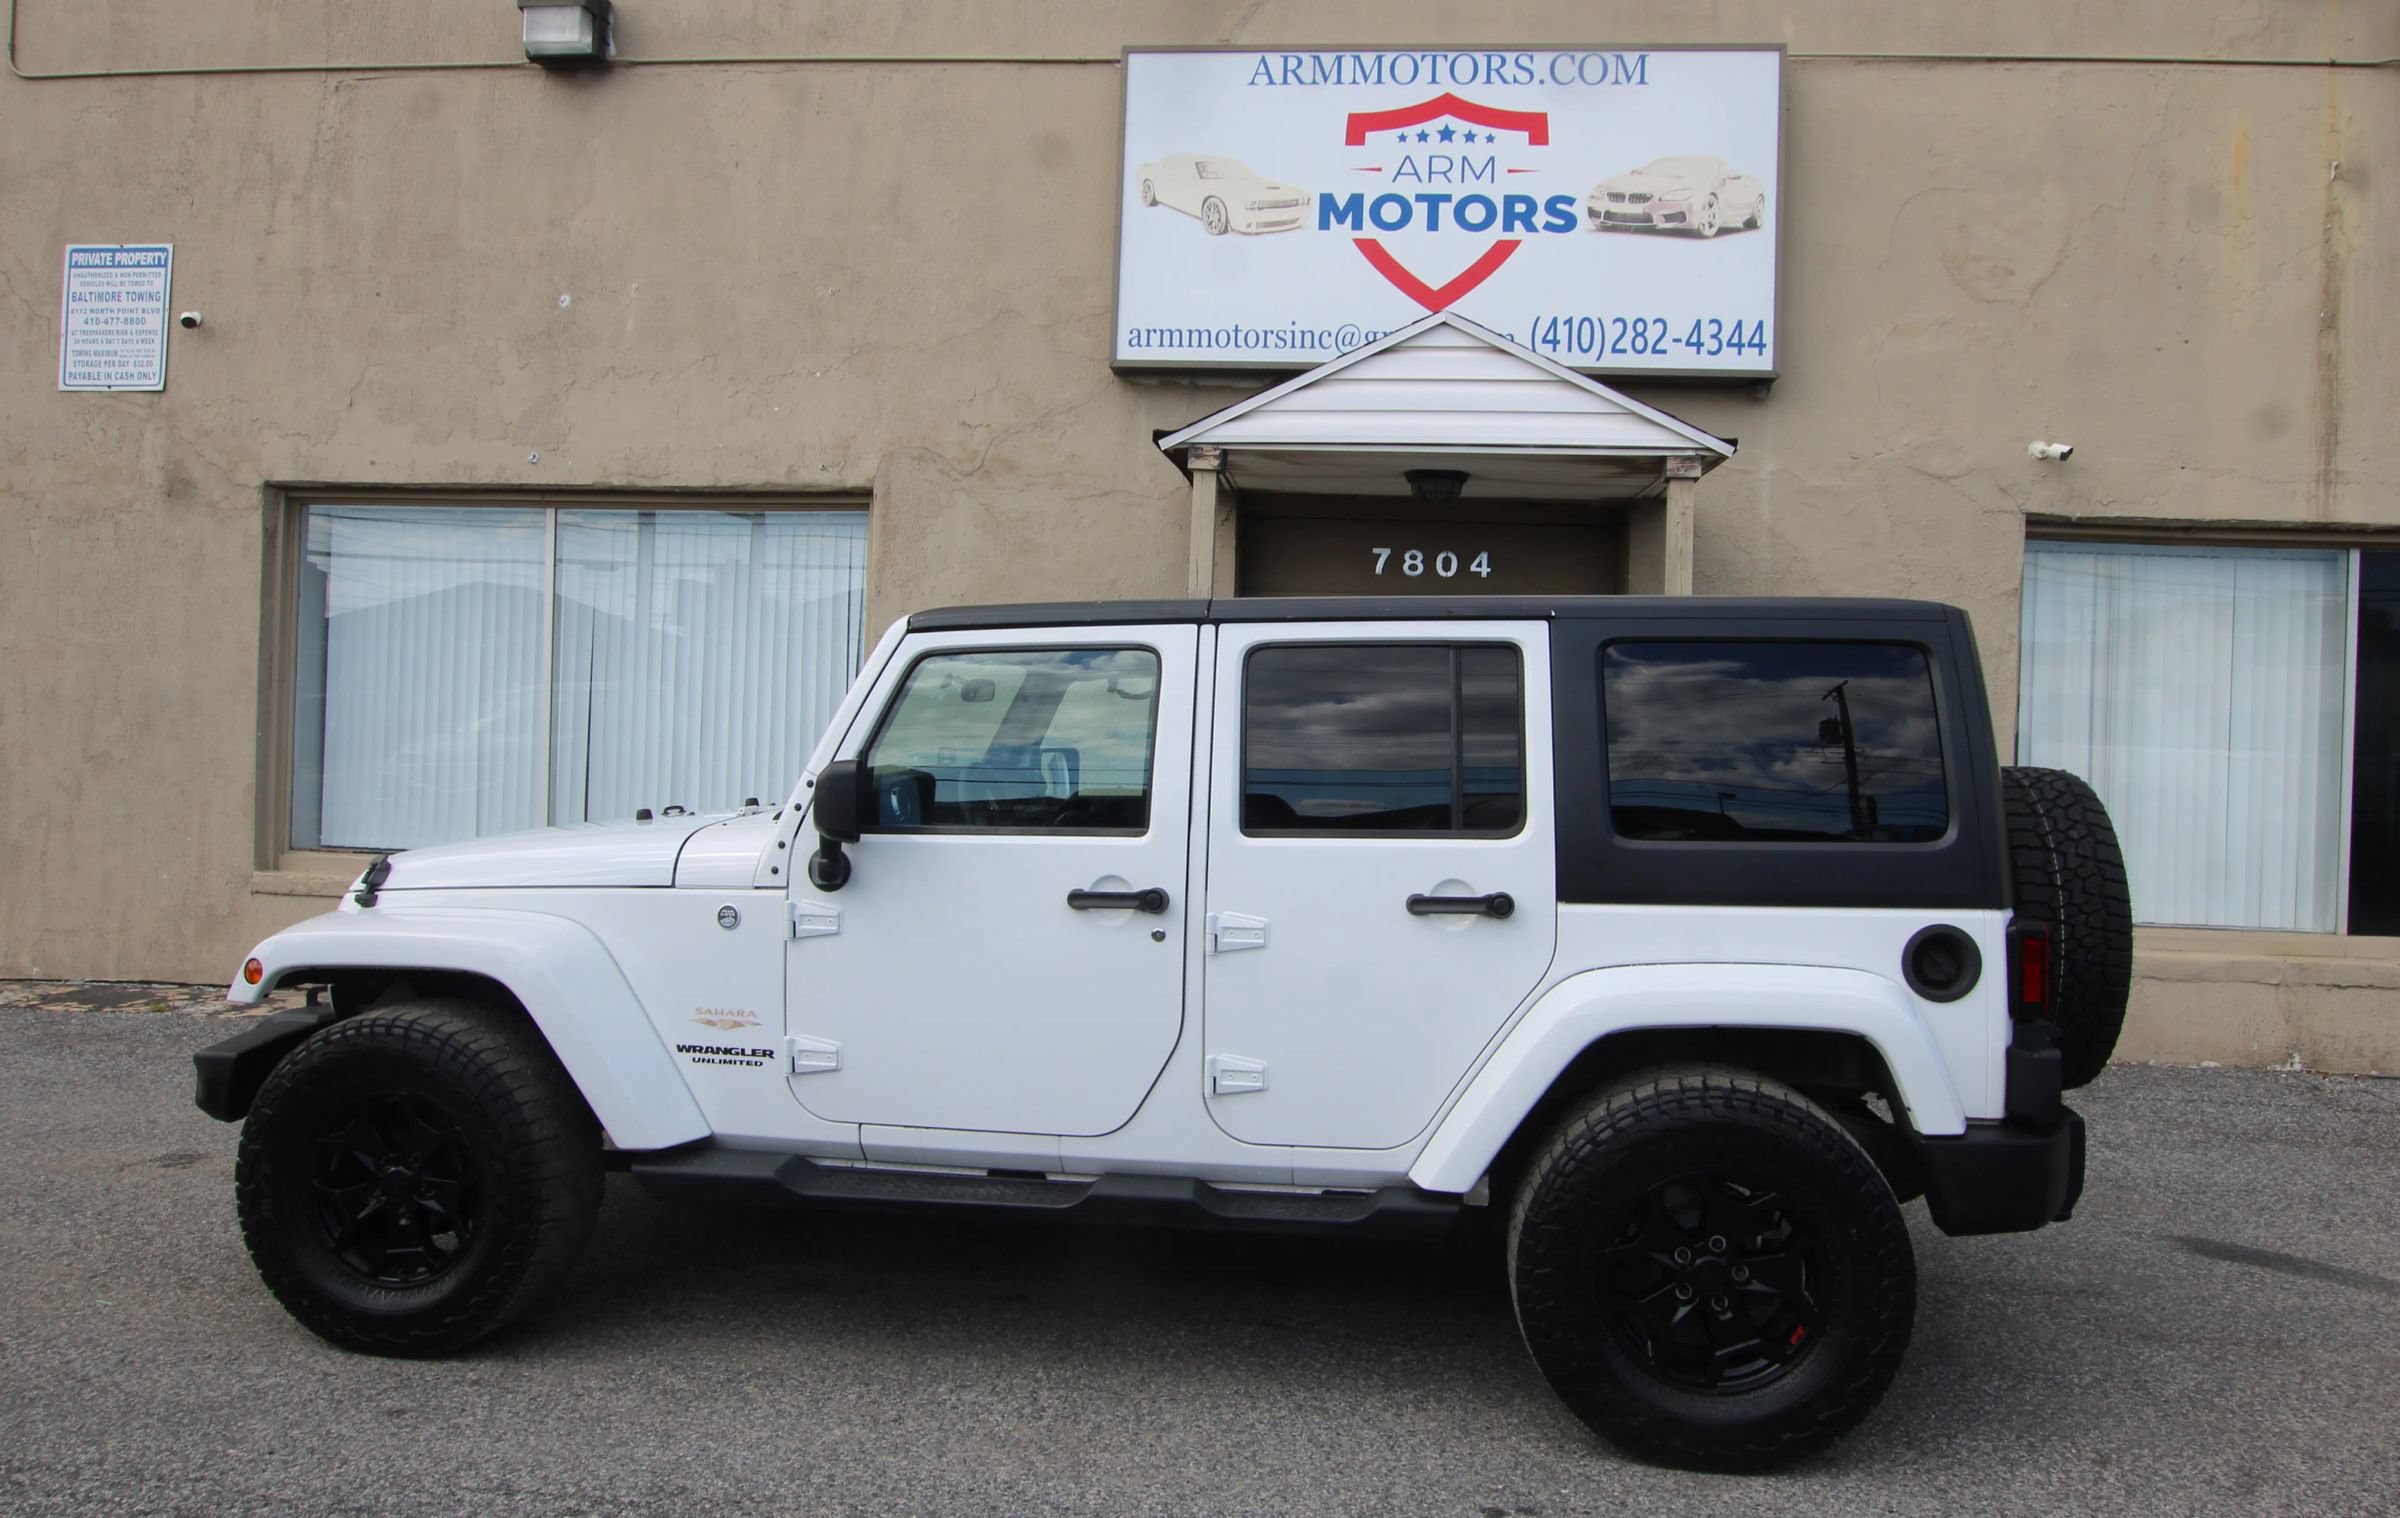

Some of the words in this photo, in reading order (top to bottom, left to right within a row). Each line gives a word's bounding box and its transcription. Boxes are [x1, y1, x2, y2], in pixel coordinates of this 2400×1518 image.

[1247, 53, 1650, 86] ARMMOTORS.COM
[1391, 154, 1496, 184] ARM
[1318, 192, 1579, 234] MOTORS
[71, 252, 113, 266] PRIVATE
[115, 252, 168, 266] PROPERTY
[72, 291, 123, 302] BALTIMORE
[125, 291, 161, 302] TOWING
[1531, 316, 1767, 362] (410)282-4344
[72, 349, 92, 358] TOWING
[73, 359, 103, 368] STORAGE
[104, 359, 116, 368] PER
[118, 359, 130, 368] DAY
[68, 371, 103, 381] PAYABLE
[104, 371, 113, 381] IN
[115, 371, 135, 381] CASH
[137, 371, 158, 381] ONLY
[1372, 547, 1492, 578] 7804
[695, 1007, 757, 1018] SAHARA
[676, 1044, 775, 1059] WRANGLER
[692, 1057, 763, 1067] UNLIMITED
